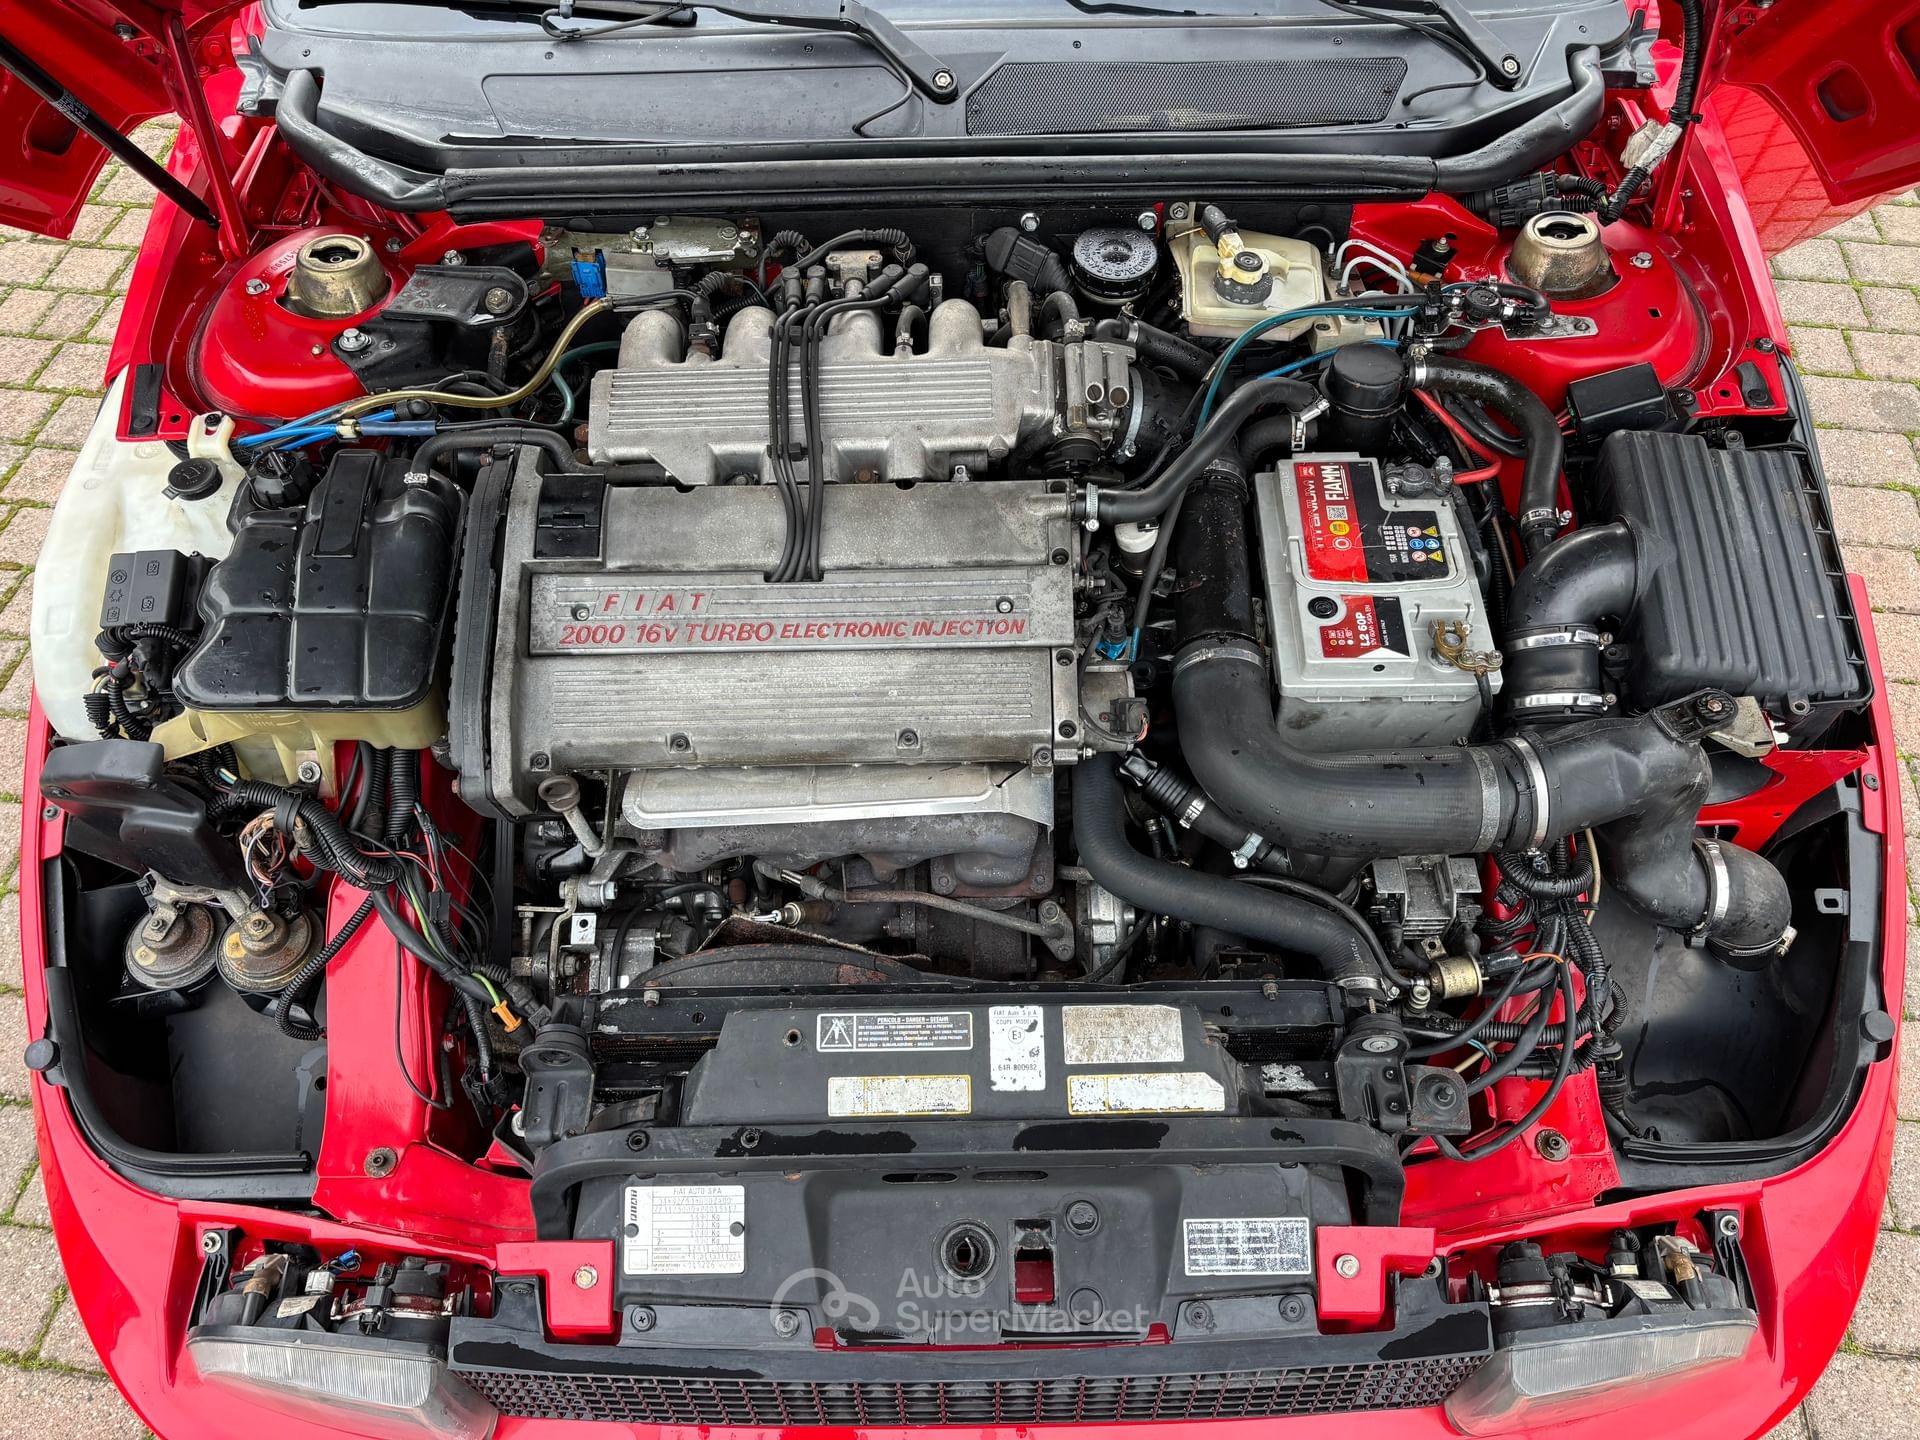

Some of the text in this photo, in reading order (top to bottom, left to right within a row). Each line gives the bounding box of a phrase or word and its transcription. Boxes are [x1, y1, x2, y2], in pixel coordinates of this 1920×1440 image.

[1320, 465, 1345, 500] FIAMM
[1303, 480, 1325, 551] TITANIUM
[603, 592, 706, 612] FIAT
[559, 623, 626, 645] 2000
[685, 621, 775, 642] TURBO
[780, 620, 909, 639] ELECTRONIC
[911, 618, 1026, 637] INJECTION
[1355, 611, 1371, 647] L2 60P
